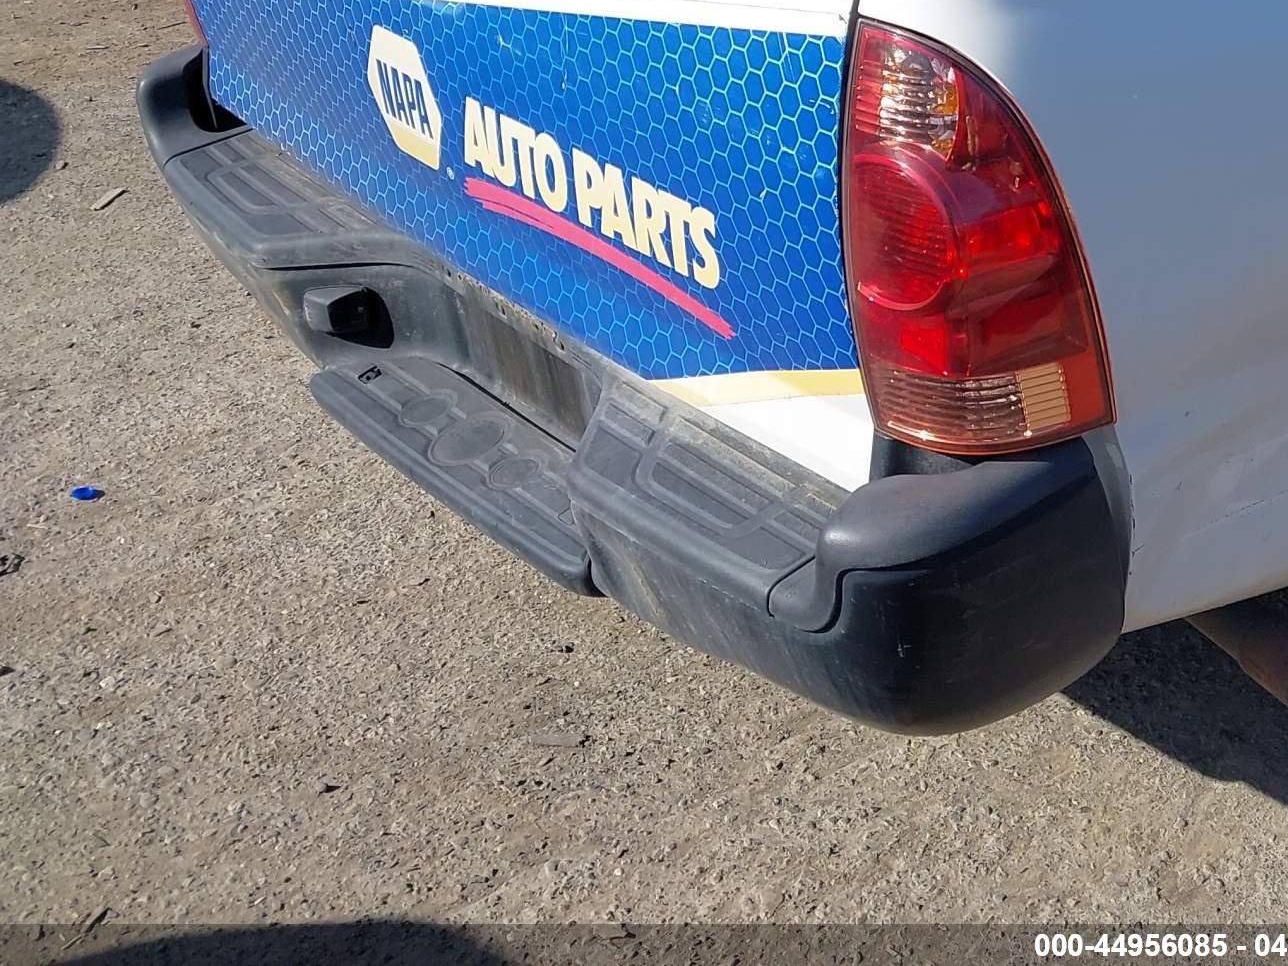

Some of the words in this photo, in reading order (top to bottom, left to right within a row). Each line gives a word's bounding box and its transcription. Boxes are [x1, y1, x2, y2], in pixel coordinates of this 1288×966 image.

[375, 58, 435, 140] NAPA
[464, 96, 568, 213] AUTO
[572, 148, 721, 290] PARTS
